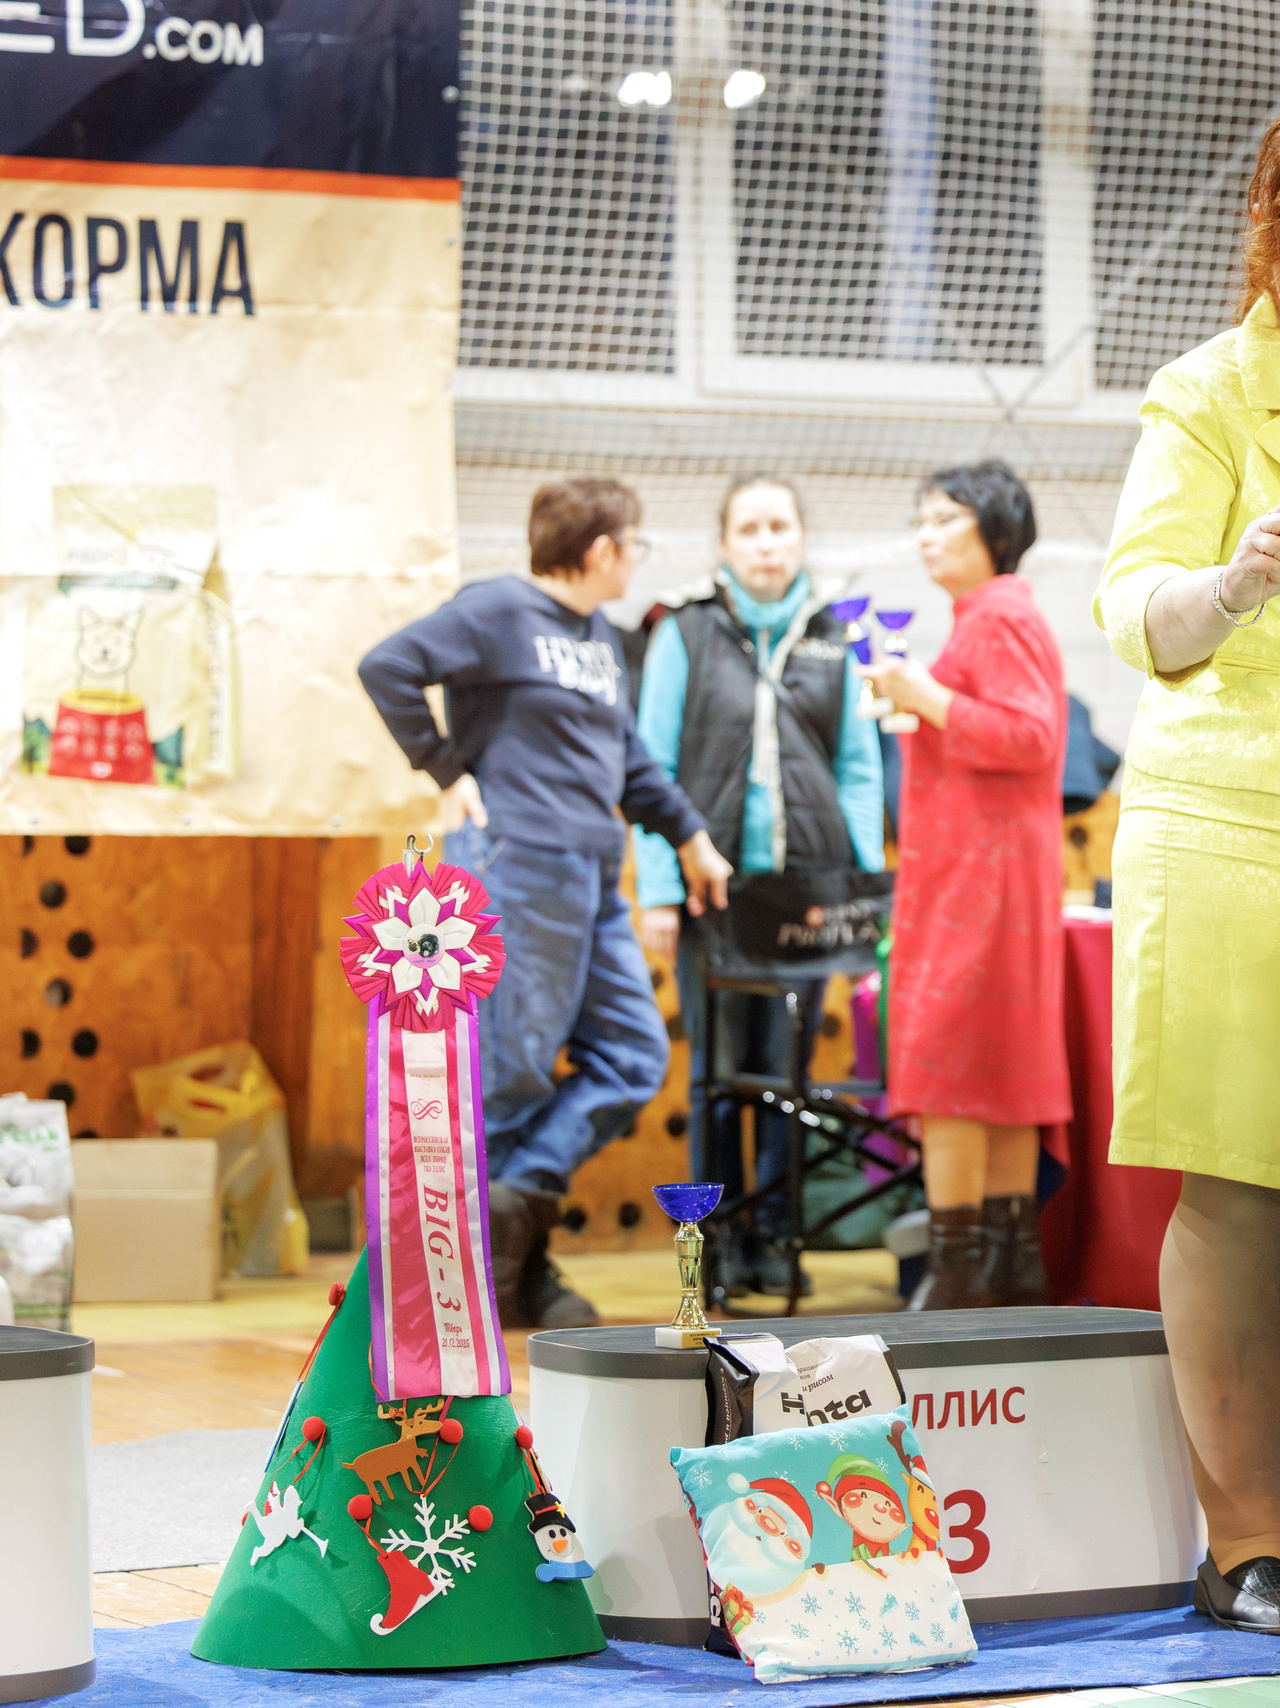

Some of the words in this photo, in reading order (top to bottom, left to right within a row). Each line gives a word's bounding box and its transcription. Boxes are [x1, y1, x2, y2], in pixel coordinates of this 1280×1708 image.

[423, 1183, 454, 1260] BIG
[436, 1291, 461, 1312] 3
[443, 1322, 463, 1337] Тверь
[808, 1373, 834, 1393] рисом
[943, 1488, 991, 1575] 3
